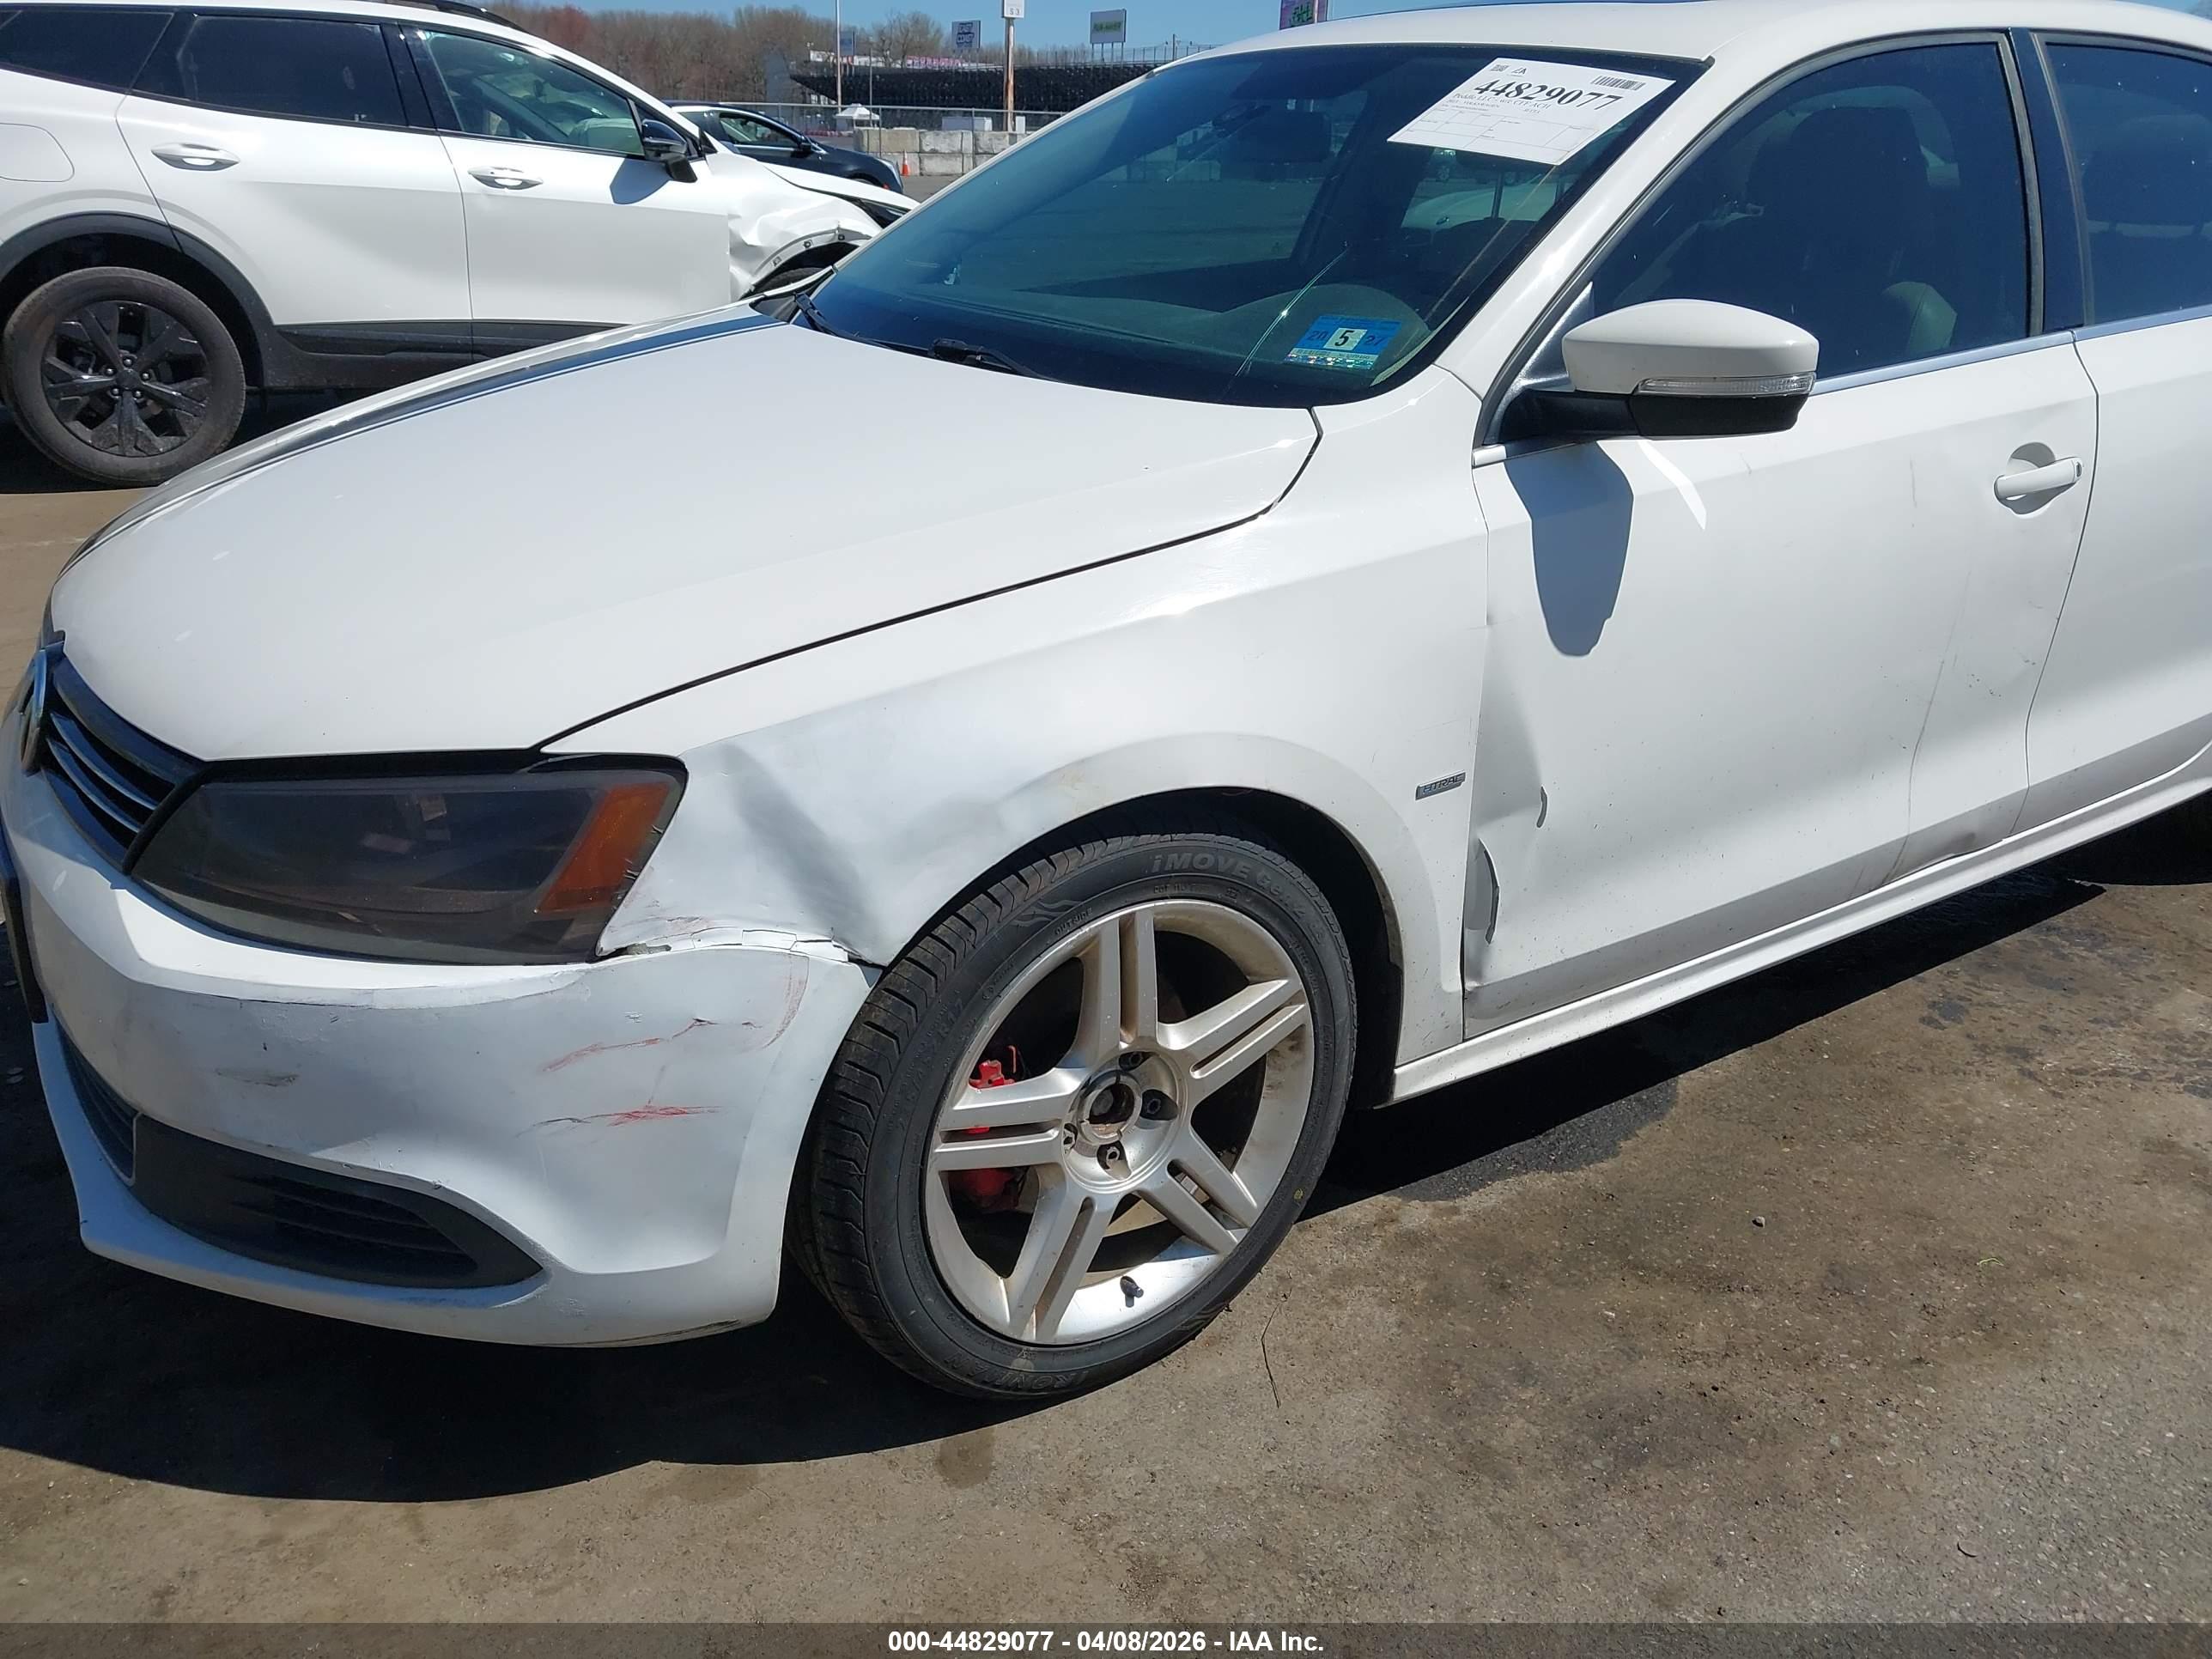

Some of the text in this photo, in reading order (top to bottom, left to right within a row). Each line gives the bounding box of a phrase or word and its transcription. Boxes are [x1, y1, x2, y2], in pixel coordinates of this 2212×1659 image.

[1474, 79, 1624, 110] 44829077
[1334, 330, 1355, 346] 5
[1054, 907, 1092, 935] OUTSIDE
